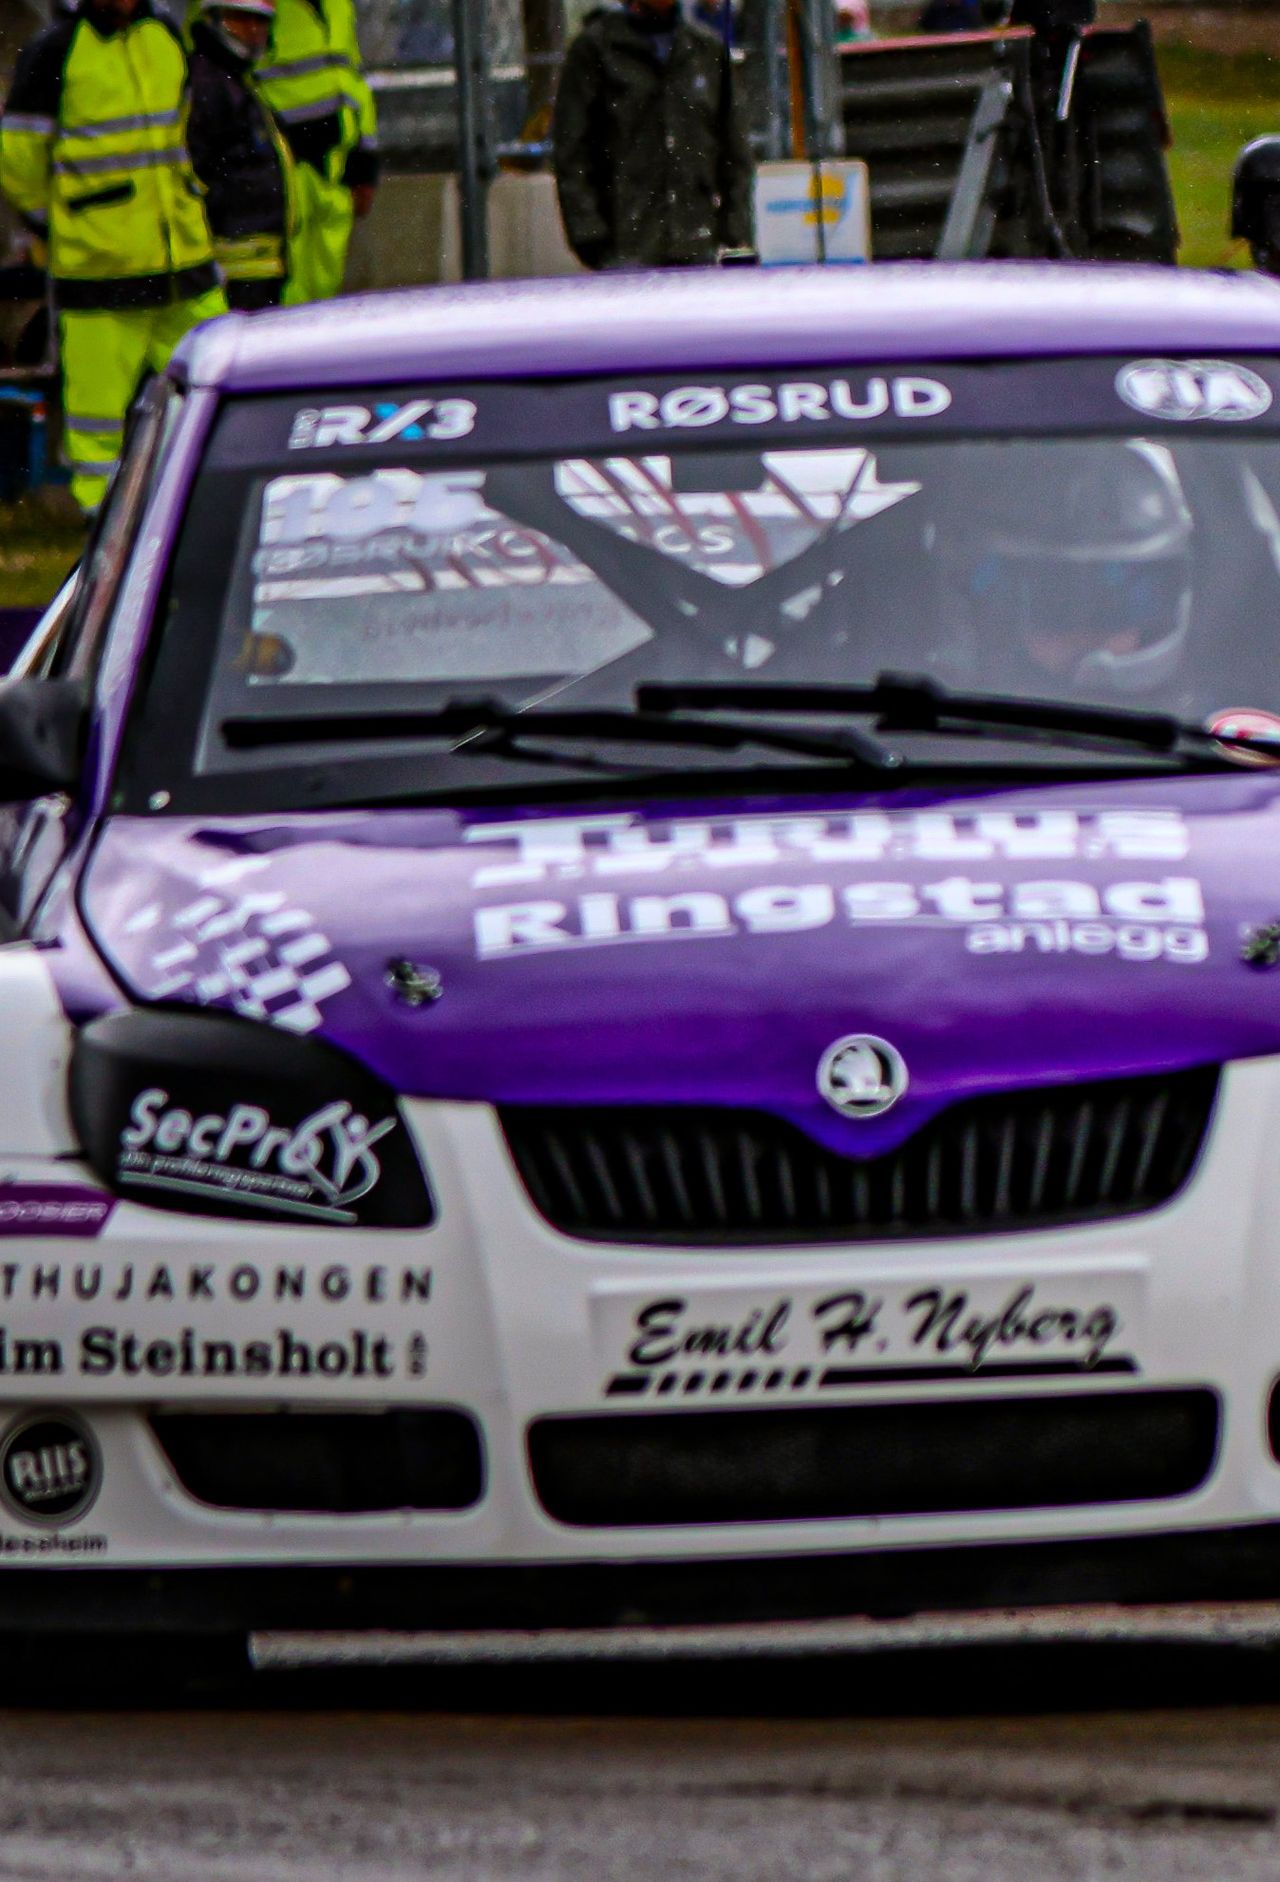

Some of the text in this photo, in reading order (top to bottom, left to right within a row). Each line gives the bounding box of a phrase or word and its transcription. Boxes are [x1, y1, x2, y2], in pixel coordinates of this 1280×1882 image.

[609, 377, 951, 432] RØSRUD
[1121, 366, 1265, 416] FIA
[474, 876, 1205, 958] Ringstad
[966, 919, 1210, 963] anlegg
[2, 1263, 433, 1301] THUJAKONGEN
[79, 1326, 394, 1377] Steinsholt
[628, 1299, 793, 1367] Emil
[904, 1281, 1121, 1373] Nyberg
